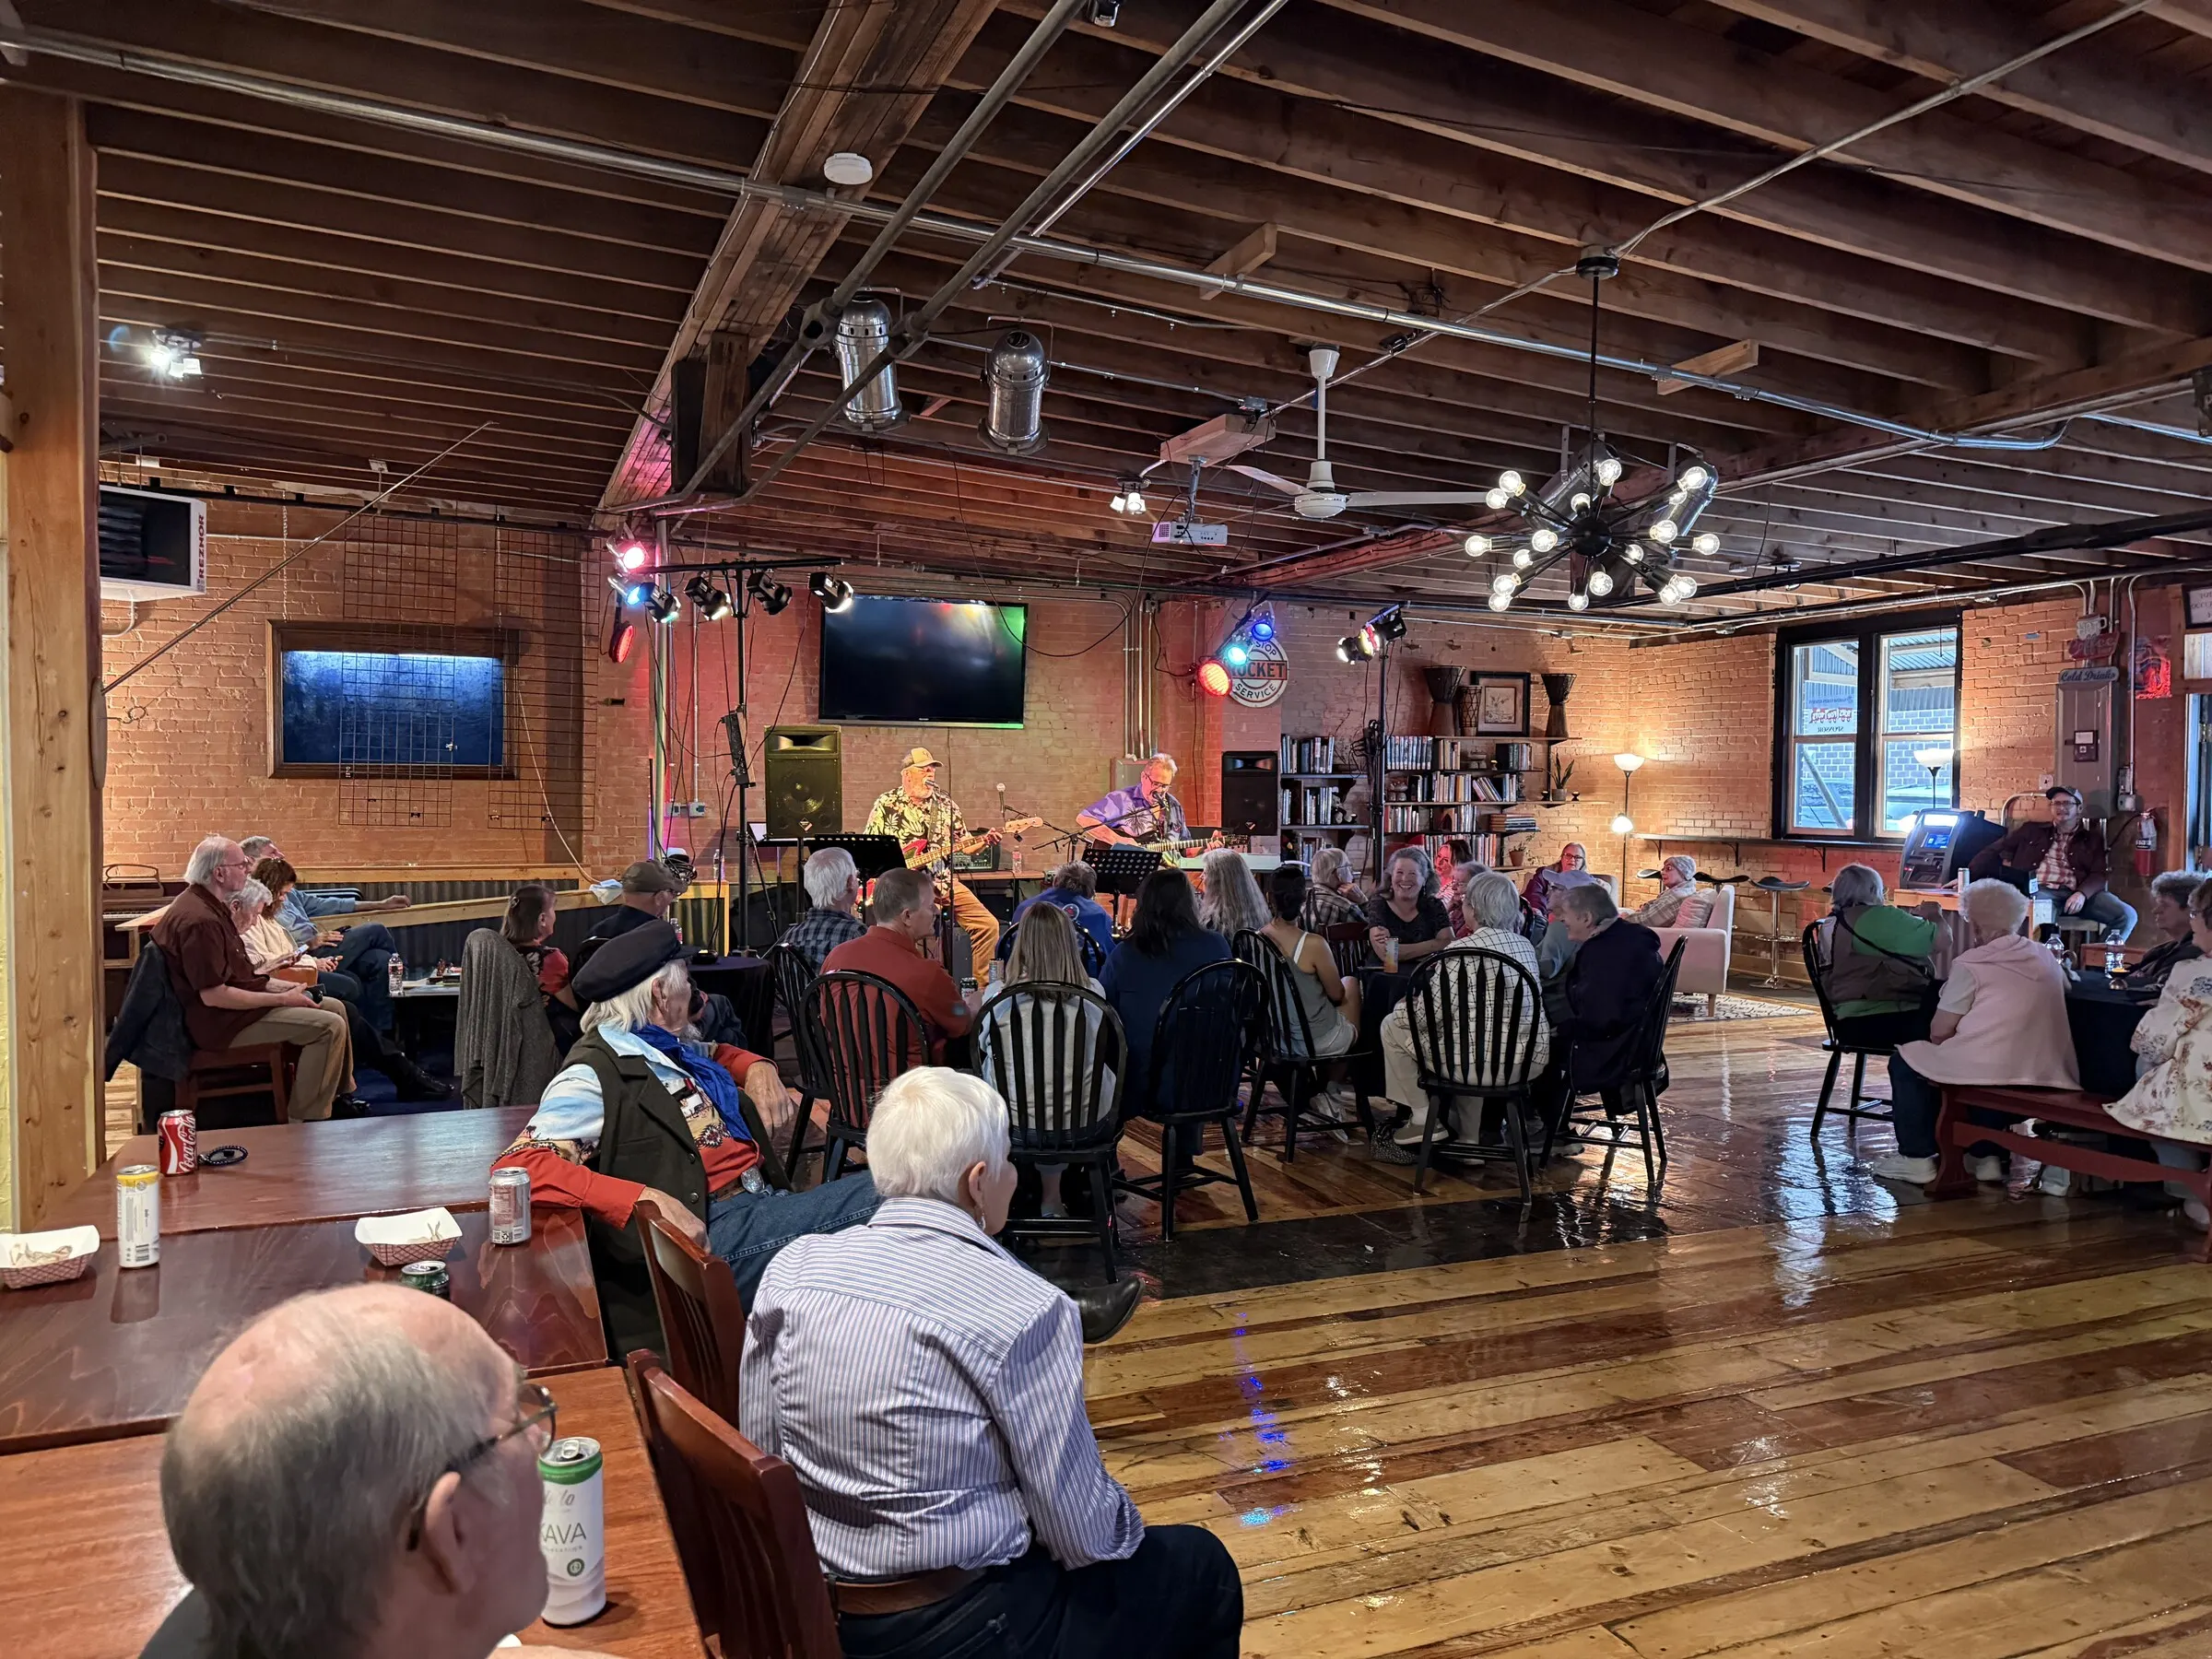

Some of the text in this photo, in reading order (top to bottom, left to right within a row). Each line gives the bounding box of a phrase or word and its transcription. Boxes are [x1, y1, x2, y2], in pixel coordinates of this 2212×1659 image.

[1256, 641, 1277, 656] STOP
[2061, 669, 2115, 681] Cold Drinks
[1236, 683, 1277, 699] SERVICE
